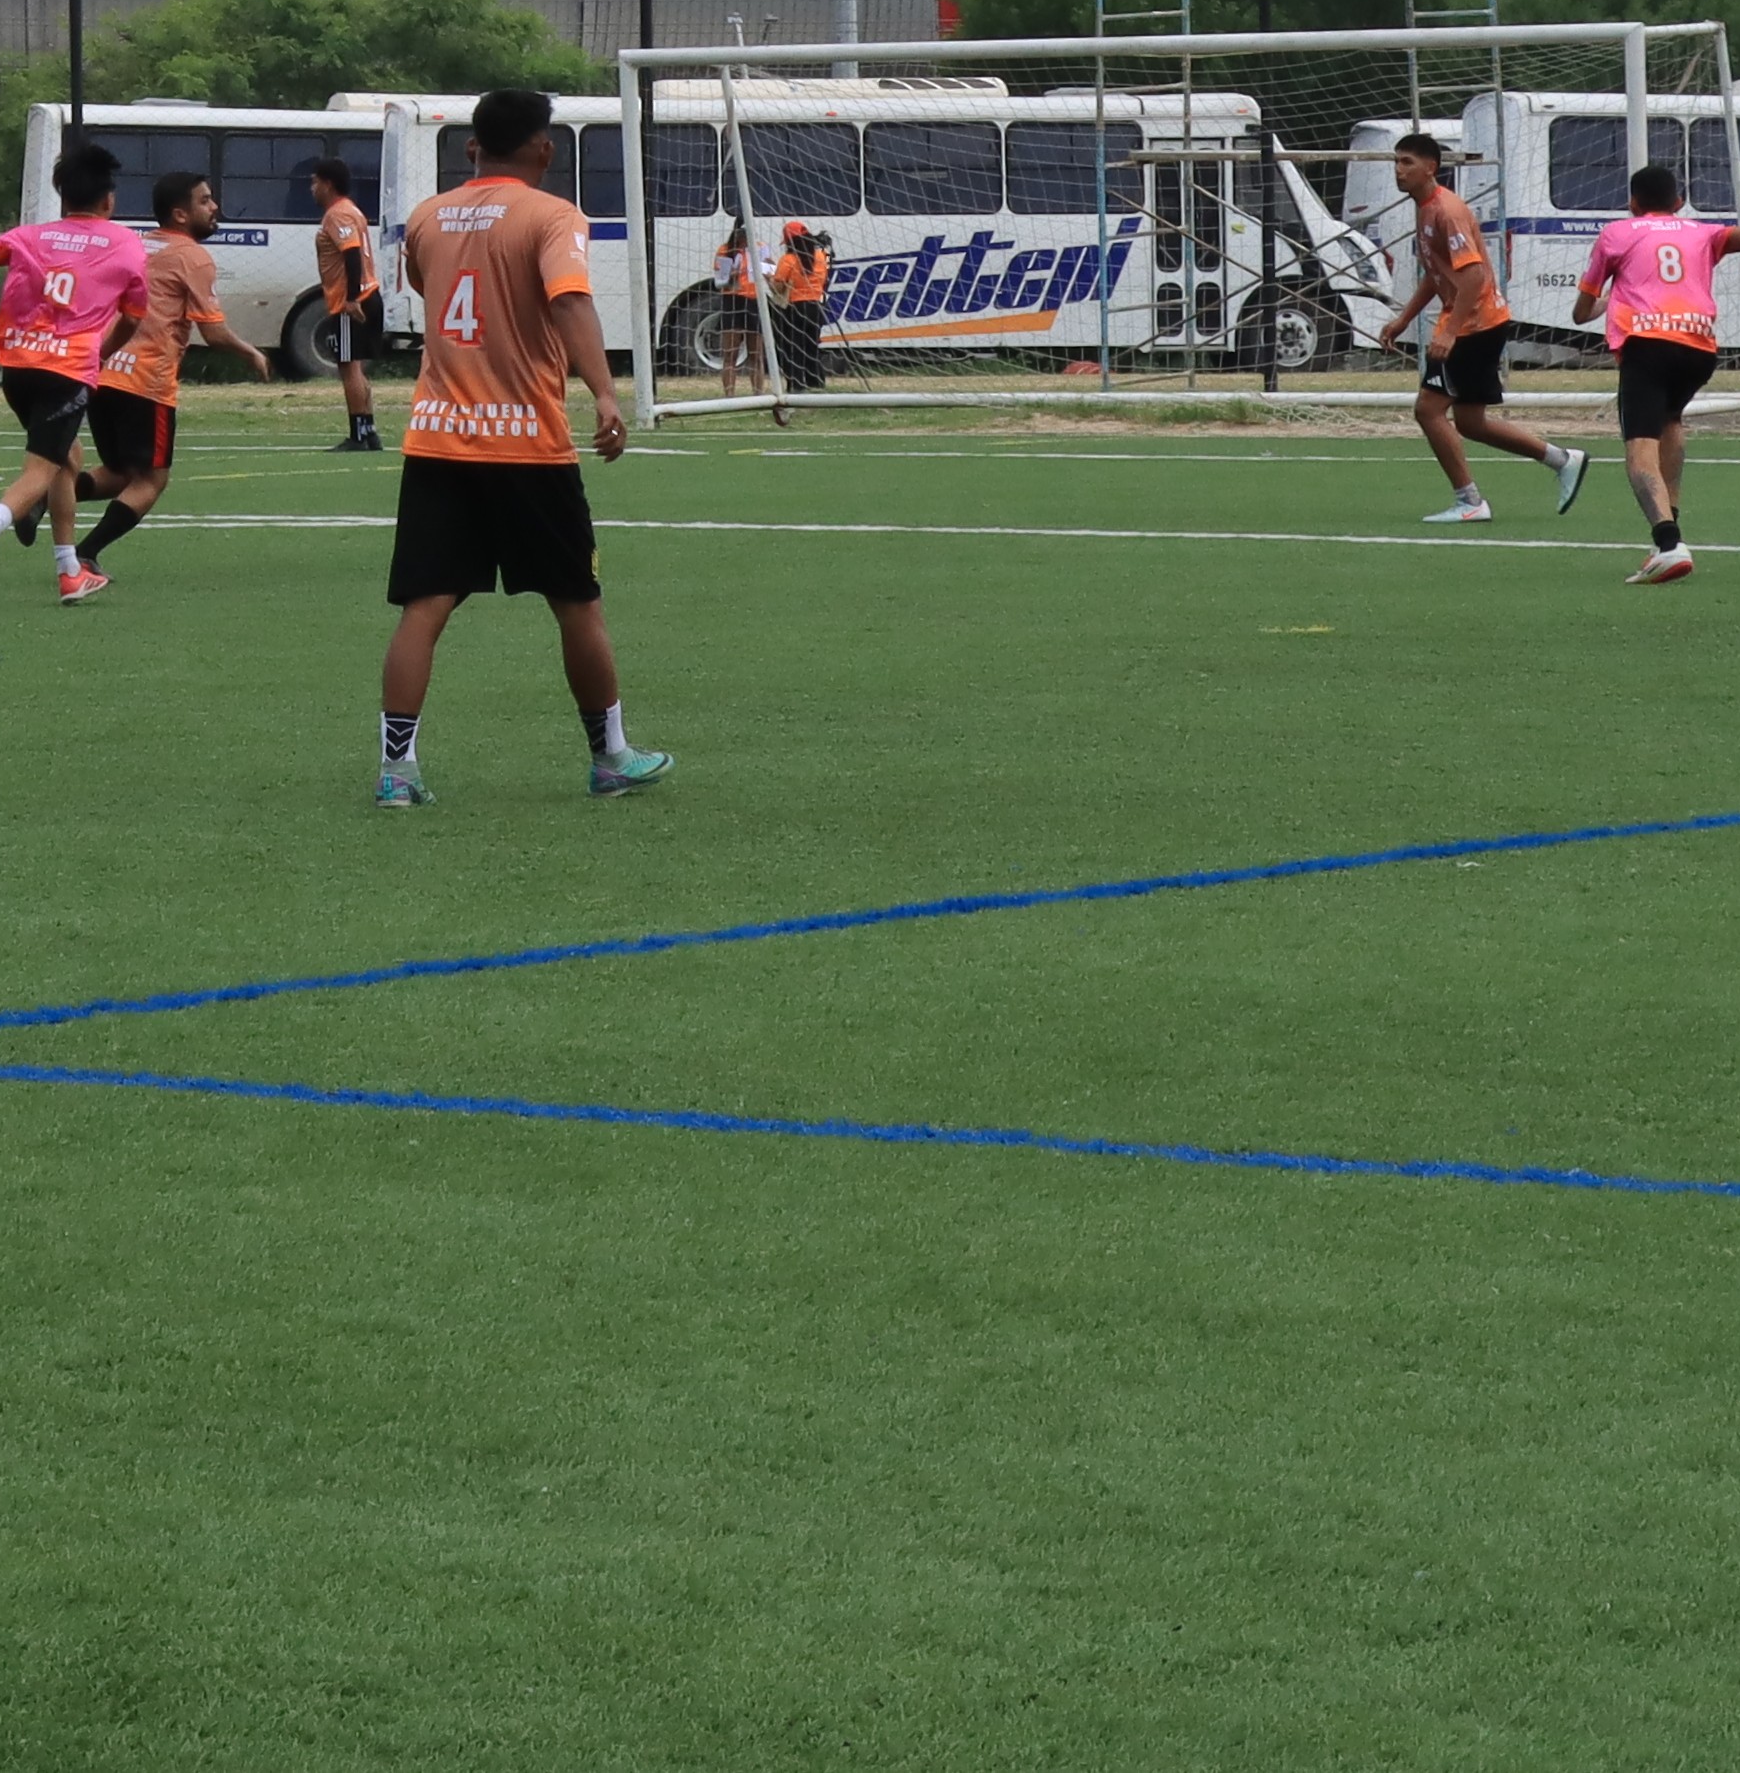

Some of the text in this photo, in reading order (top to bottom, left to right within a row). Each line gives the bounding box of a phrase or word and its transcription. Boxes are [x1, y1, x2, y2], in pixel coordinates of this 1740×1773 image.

[437, 206, 460, 220] SAN
[227, 232, 245, 243] GPS
[1656, 244, 1684, 284] 8
[443, 274, 479, 342] 4
